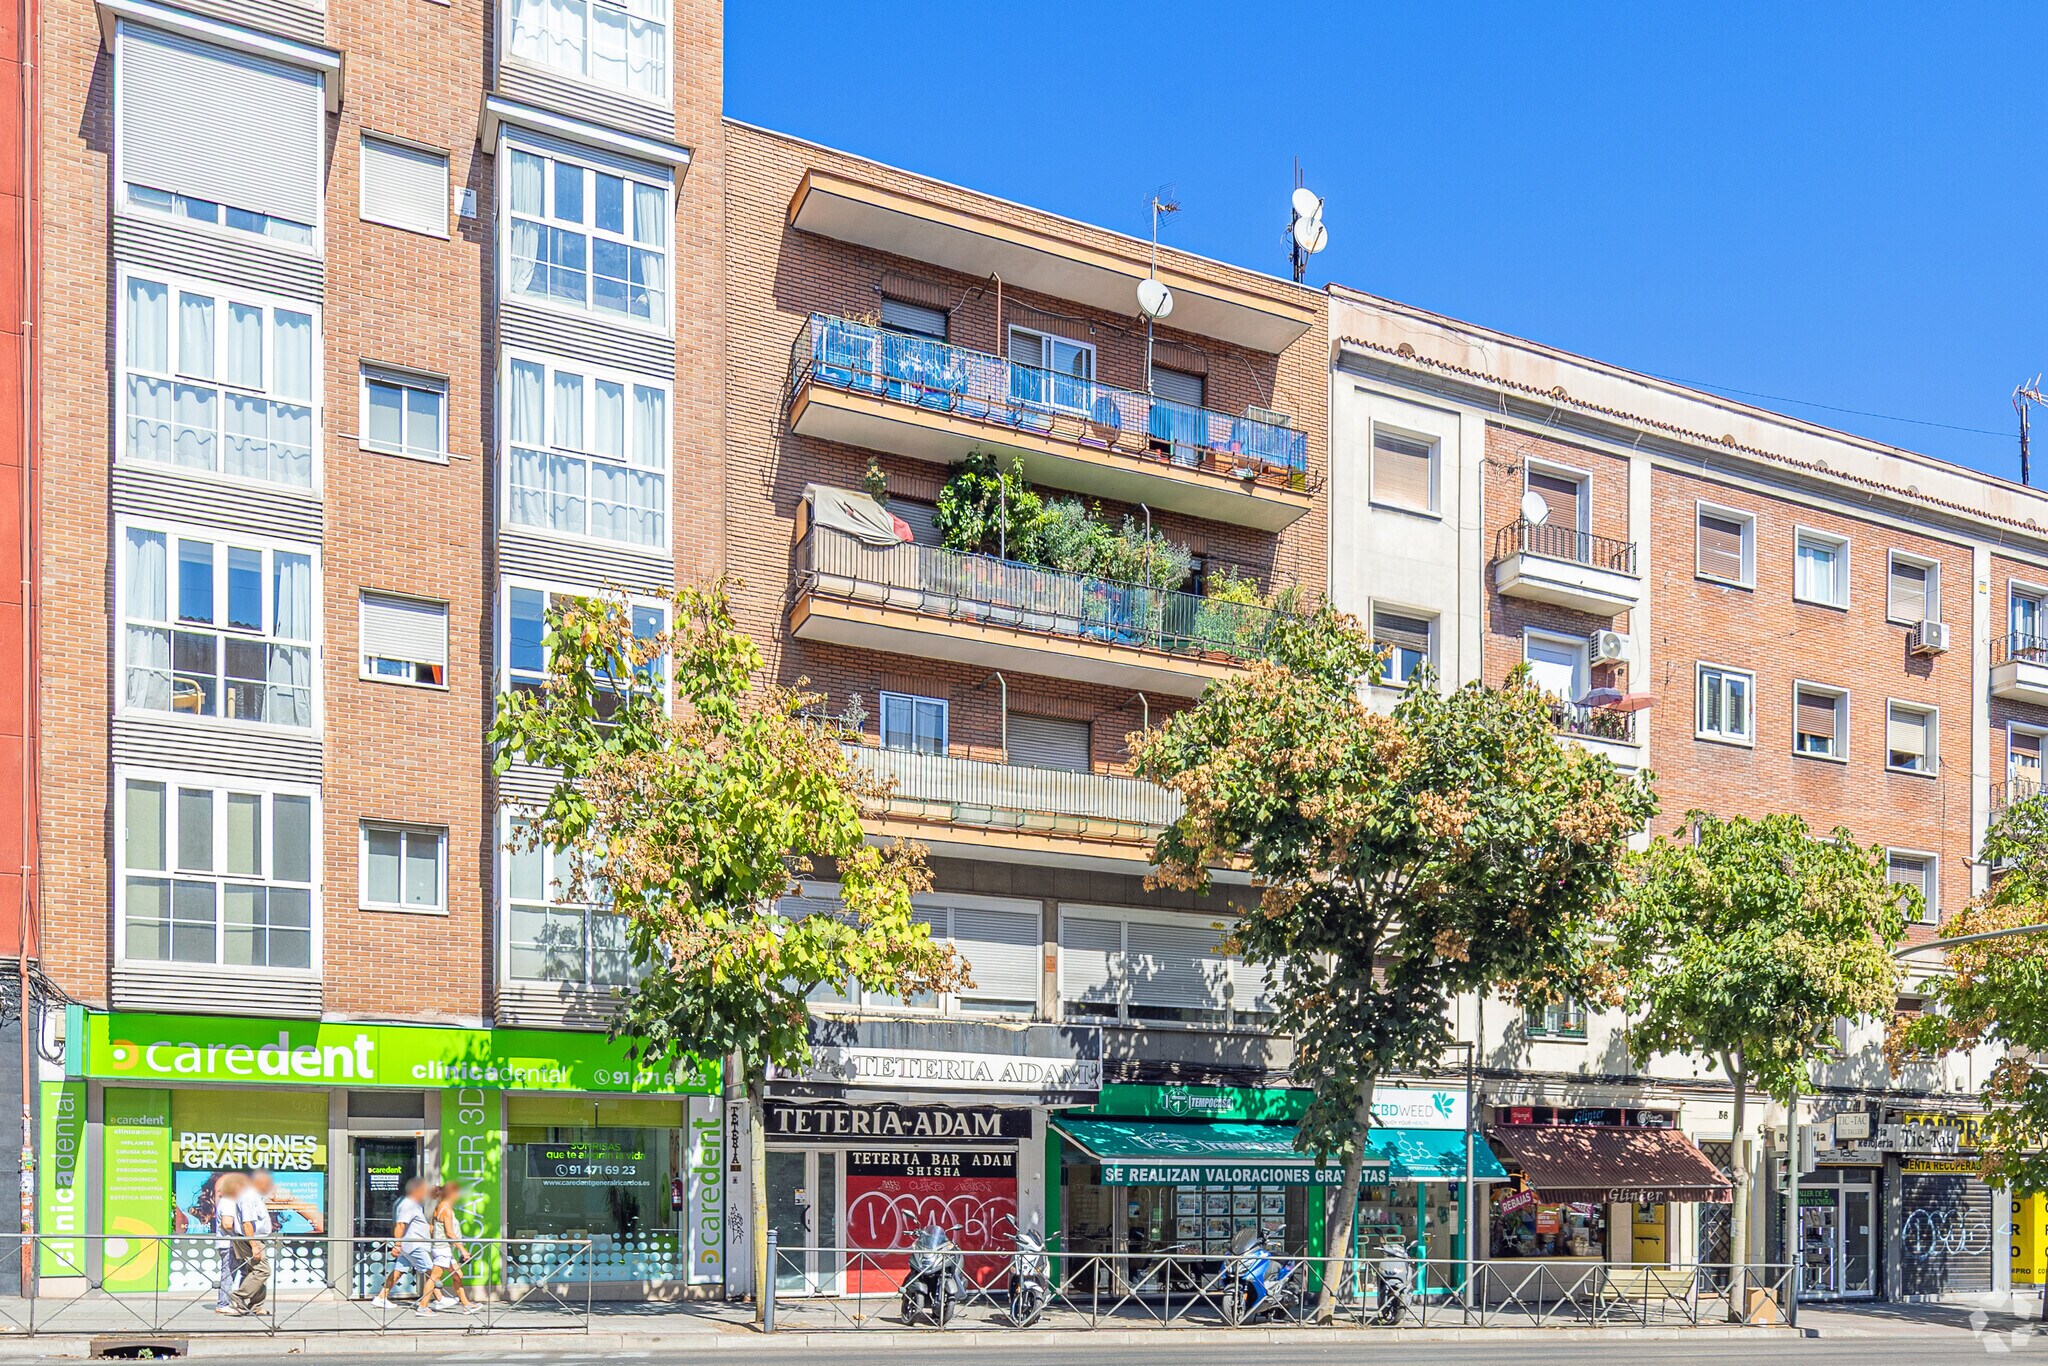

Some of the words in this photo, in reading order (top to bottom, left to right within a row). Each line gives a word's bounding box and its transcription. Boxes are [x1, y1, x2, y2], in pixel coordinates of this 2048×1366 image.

[146, 1031, 374, 1079] caredent
[852, 1054, 993, 1082] TETERIA
[998, 1062, 1089, 1085] ADAM
[613, 1071, 629, 1085] 91
[633, 1071, 659, 1085] 471
[459, 1089, 485, 1125] 3D
[1191, 1097, 1232, 1108] TEMPOCASA
[117, 1115, 164, 1125] caredent
[1838, 1115, 1867, 1126] TIC-TAC
[180, 1132, 318, 1153] REVISIONES
[1206, 1141, 1294, 1153] TEMPOCAS
[183, 1150, 312, 1171] GRATUITAS
[546, 1151, 564, 1160] que
[567, 1151, 577, 1159] te
[626, 1151, 646, 1160] vida
[853, 1153, 920, 1165] TETERIA
[931, 1153, 961, 1166] BAR
[972, 1154, 1012, 1167] ADAM
[372, 1166, 402, 1174] caredent
[569, 1165, 581, 1175] 91
[583, 1165, 602, 1175] 471
[605, 1166, 619, 1175] 69
[622, 1166, 636, 1175] 23
[906, 1166, 961, 1177] SHISHA
[1105, 1168, 1123, 1182] SE
[1129, 1168, 1200, 1182] REALIZAN
[1205, 1168, 1310, 1182] VALORACIONES
[1315, 1169, 1386, 1183] GRATITAS
[51, 1092, 75, 1267] clnicadental
[692, 1117, 721, 1247] caredent
[1502, 1192, 1532, 1212] REBAJAS
[1609, 1188, 1664, 1202] Glinter
